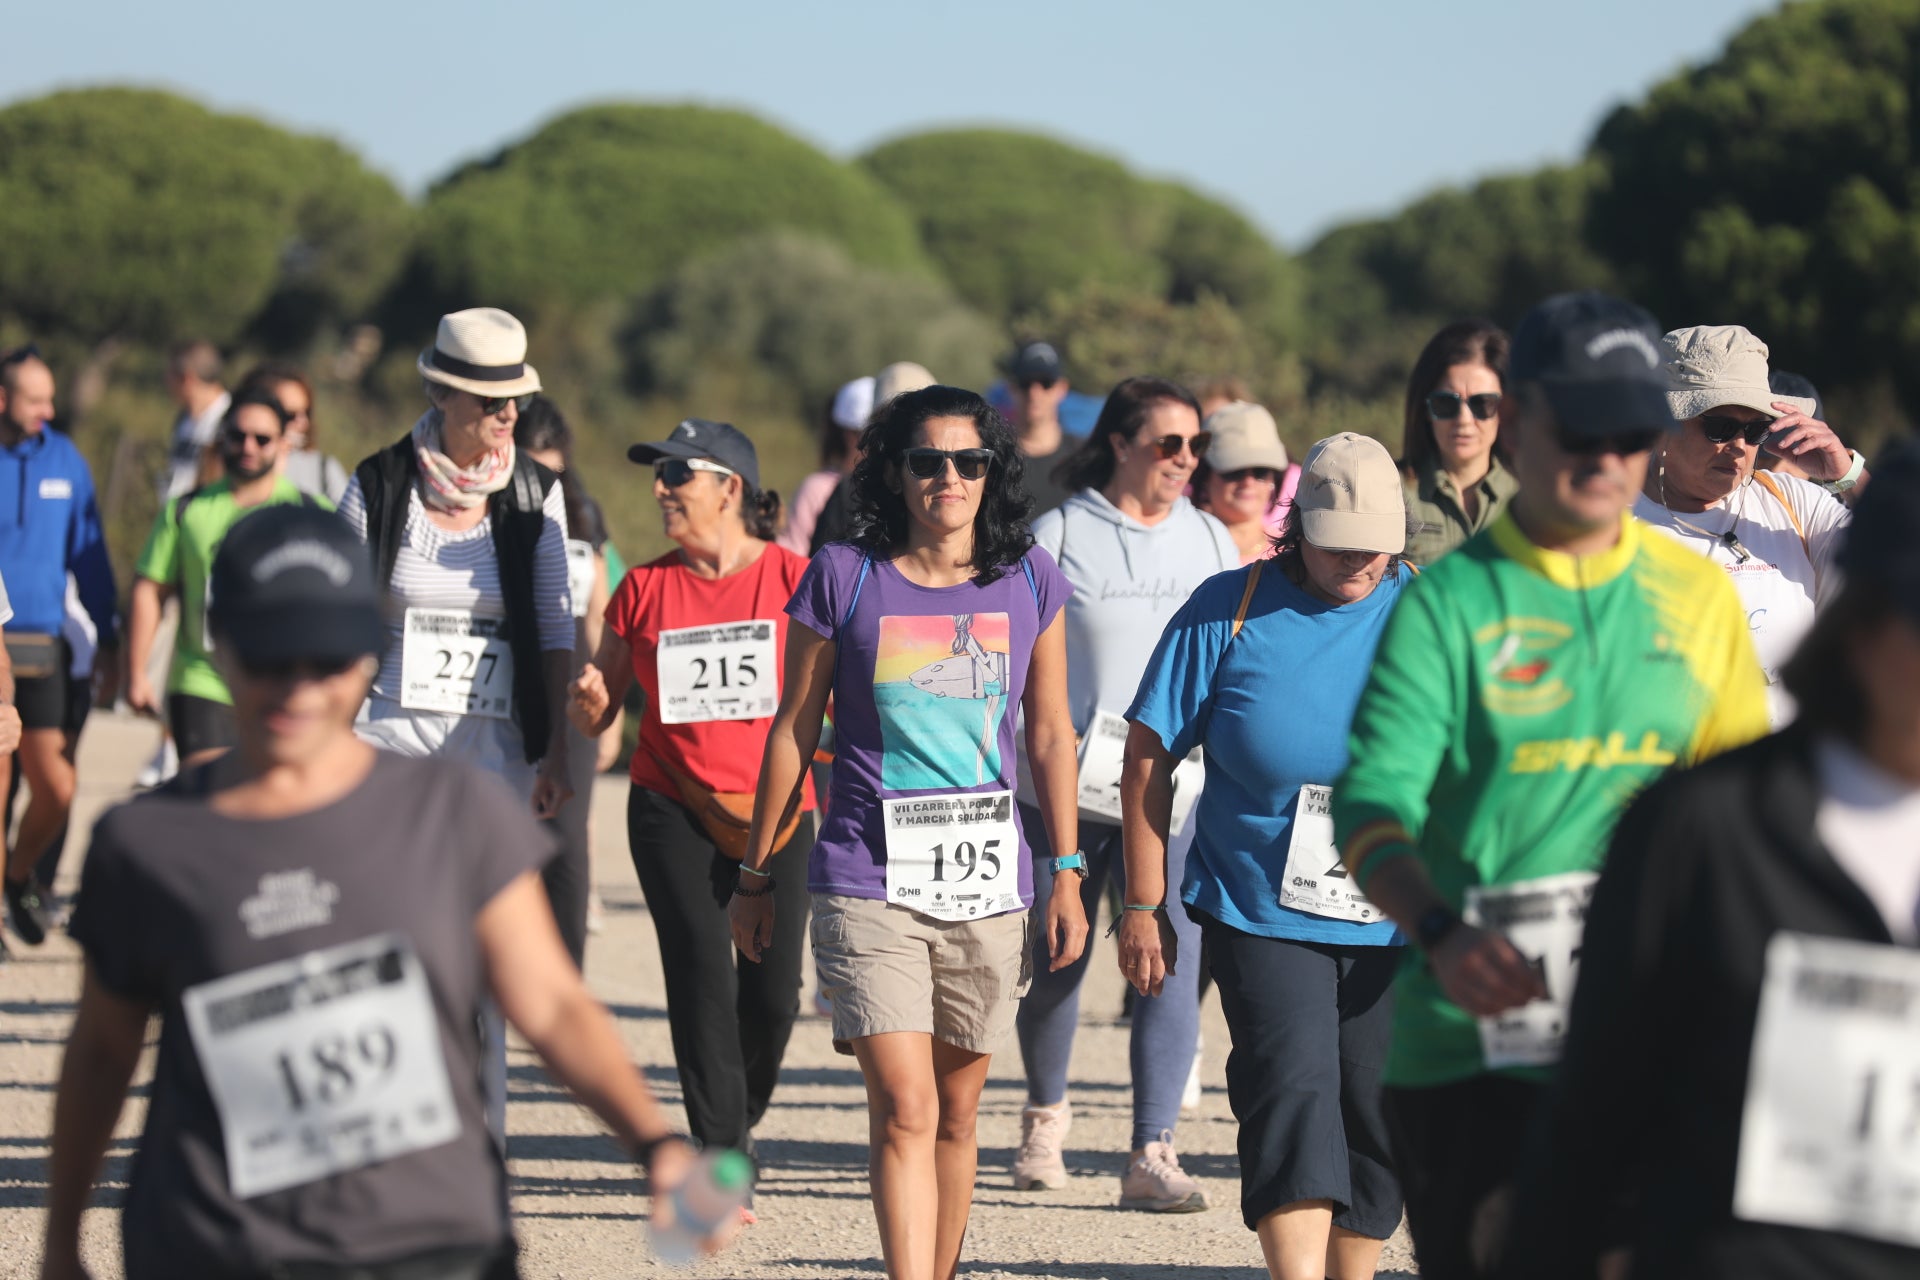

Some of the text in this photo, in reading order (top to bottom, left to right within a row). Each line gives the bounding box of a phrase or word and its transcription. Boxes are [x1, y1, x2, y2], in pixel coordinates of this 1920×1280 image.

[434, 649, 498, 685] 227
[688, 654, 758, 690] 215
[1309, 790, 1325, 802] VII
[894, 805, 910, 814] VII
[913, 802, 966, 812] CARRERA
[1307, 803, 1315, 812] Y
[895, 817, 902, 825] Y
[906, 814, 955, 825] MARCHA
[928, 839, 1001, 882] 195
[1303, 879, 1318, 888] NB
[907, 888, 921, 896] NB
[275, 1020, 397, 1114] 189
